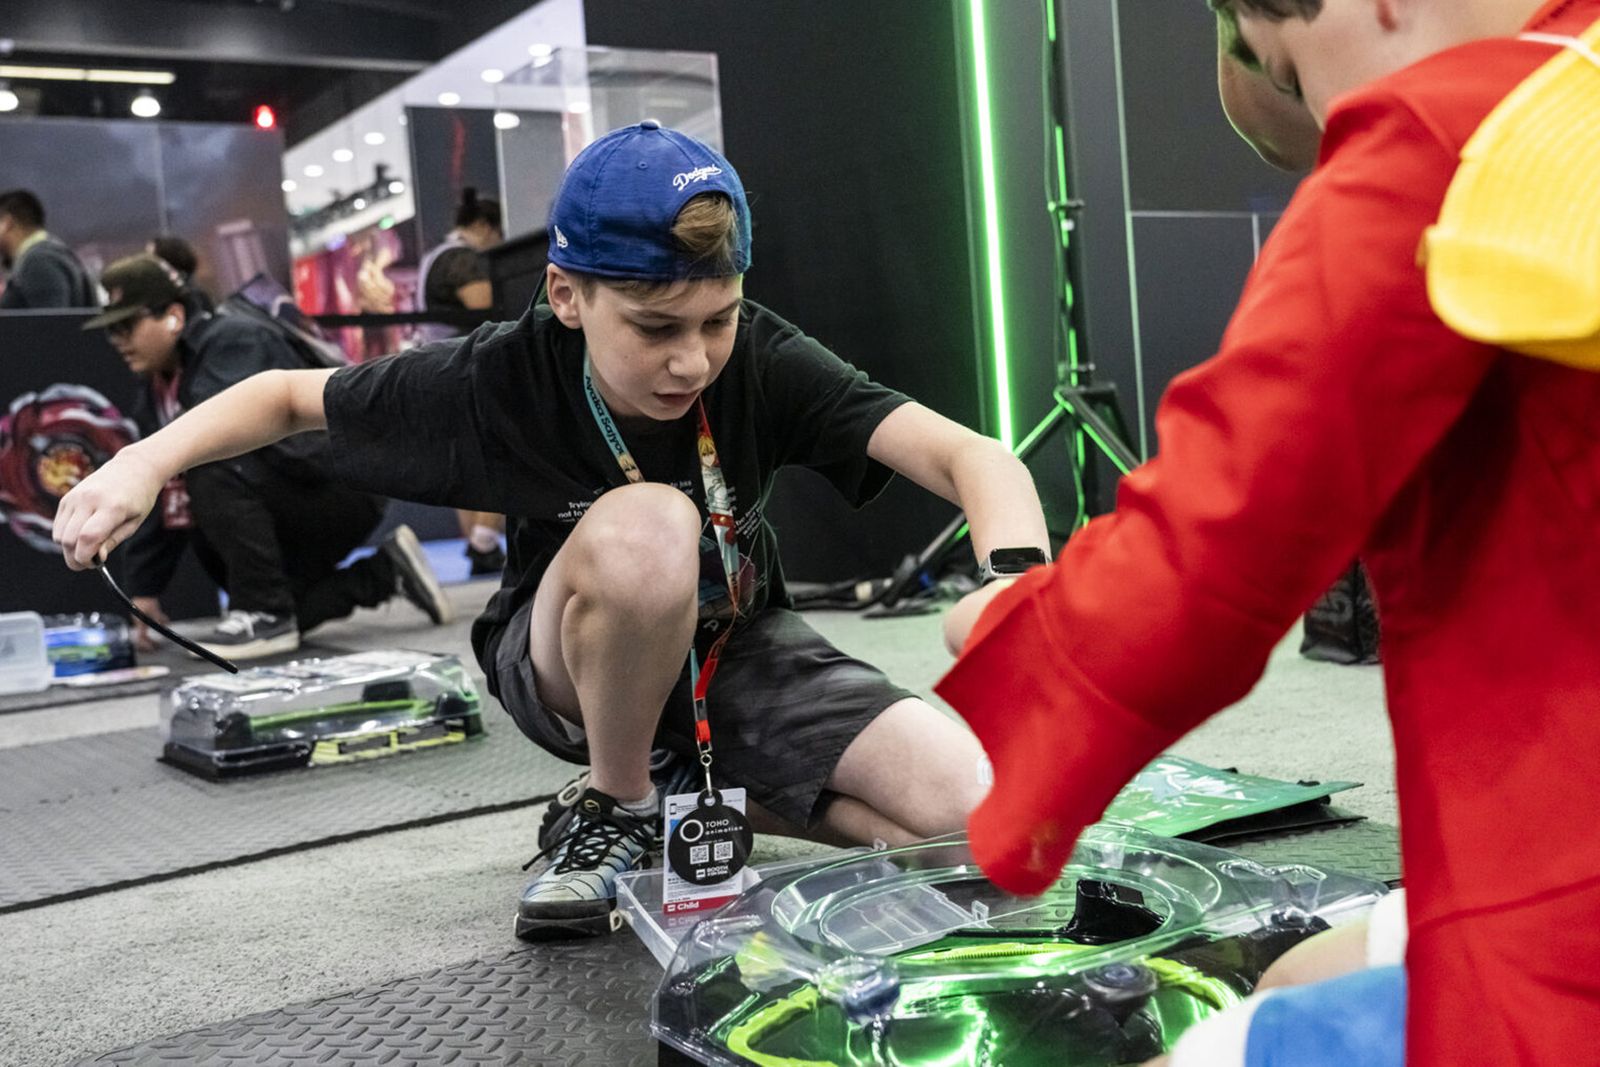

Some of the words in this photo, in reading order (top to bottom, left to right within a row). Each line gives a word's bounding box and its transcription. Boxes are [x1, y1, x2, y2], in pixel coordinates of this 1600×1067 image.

[673, 164, 722, 191] Dodgers
[585, 376, 605, 416] Ayaka
[558, 511, 572, 519] not
[705, 819, 729, 829] TOHO
[705, 825, 743, 836] animation
[677, 901, 699, 911] Child
